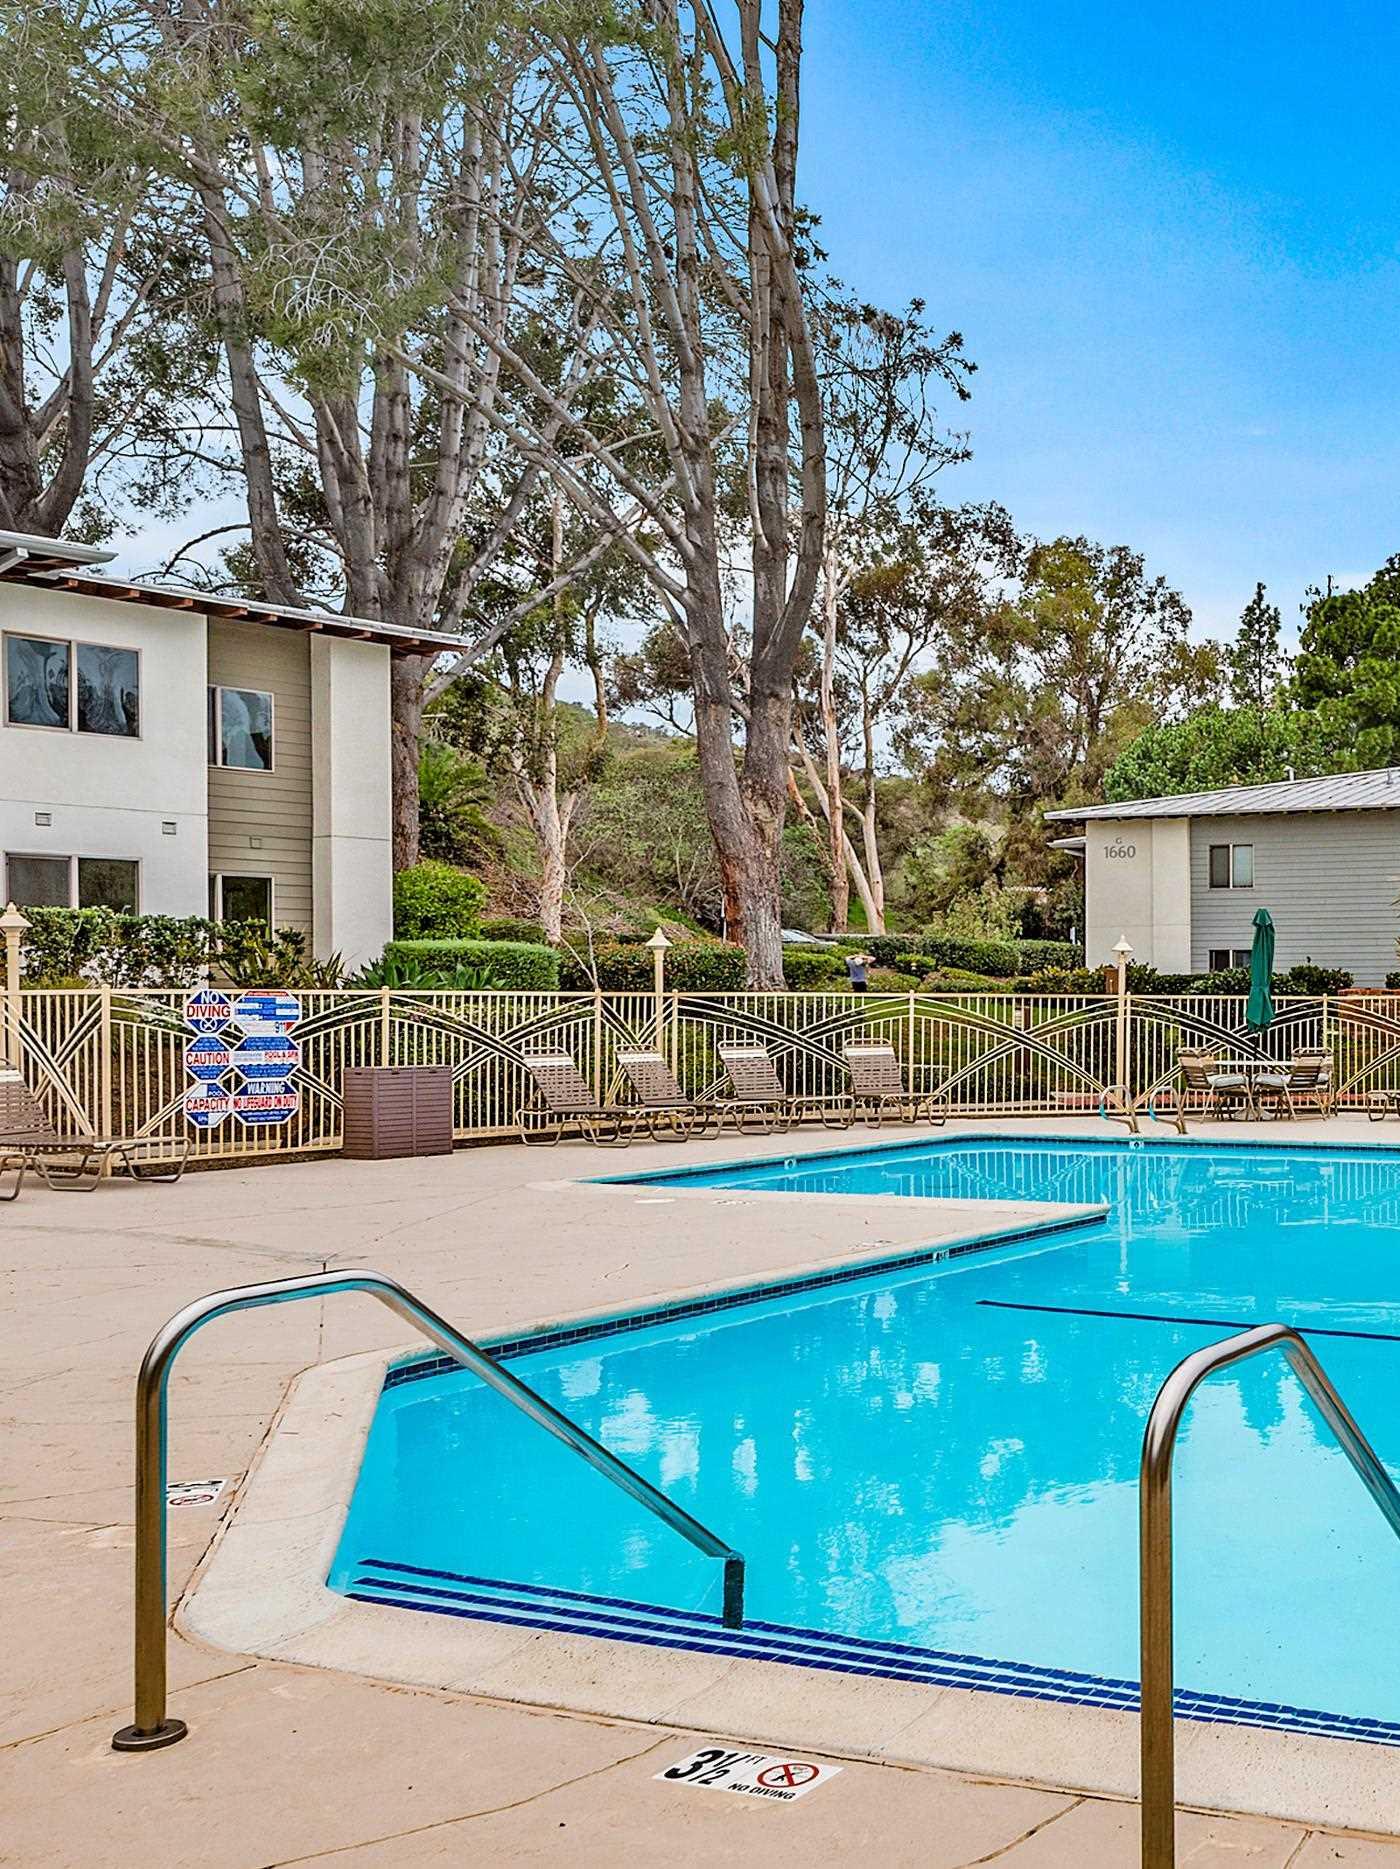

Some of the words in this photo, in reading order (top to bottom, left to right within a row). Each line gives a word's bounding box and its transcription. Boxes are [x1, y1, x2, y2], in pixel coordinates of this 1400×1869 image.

[1104, 845, 1136, 859] 1660
[201, 991, 219, 1004] NO
[186, 1005, 231, 1018] DIVING
[186, 1052, 230, 1065] CAUTION
[247, 1081, 286, 1095] WARNING
[186, 1097, 230, 1111] CAPACITY
[233, 1097, 241, 1109] NO
[242, 1096, 272, 1109] LIFEGUARD
[274, 1095, 282, 1108] ON
[283, 1095, 297, 1107] DUTY
[745, 1754, 769, 1766] FT
[727, 1782, 751, 1793] NO
[749, 1786, 797, 1801] DIVING
